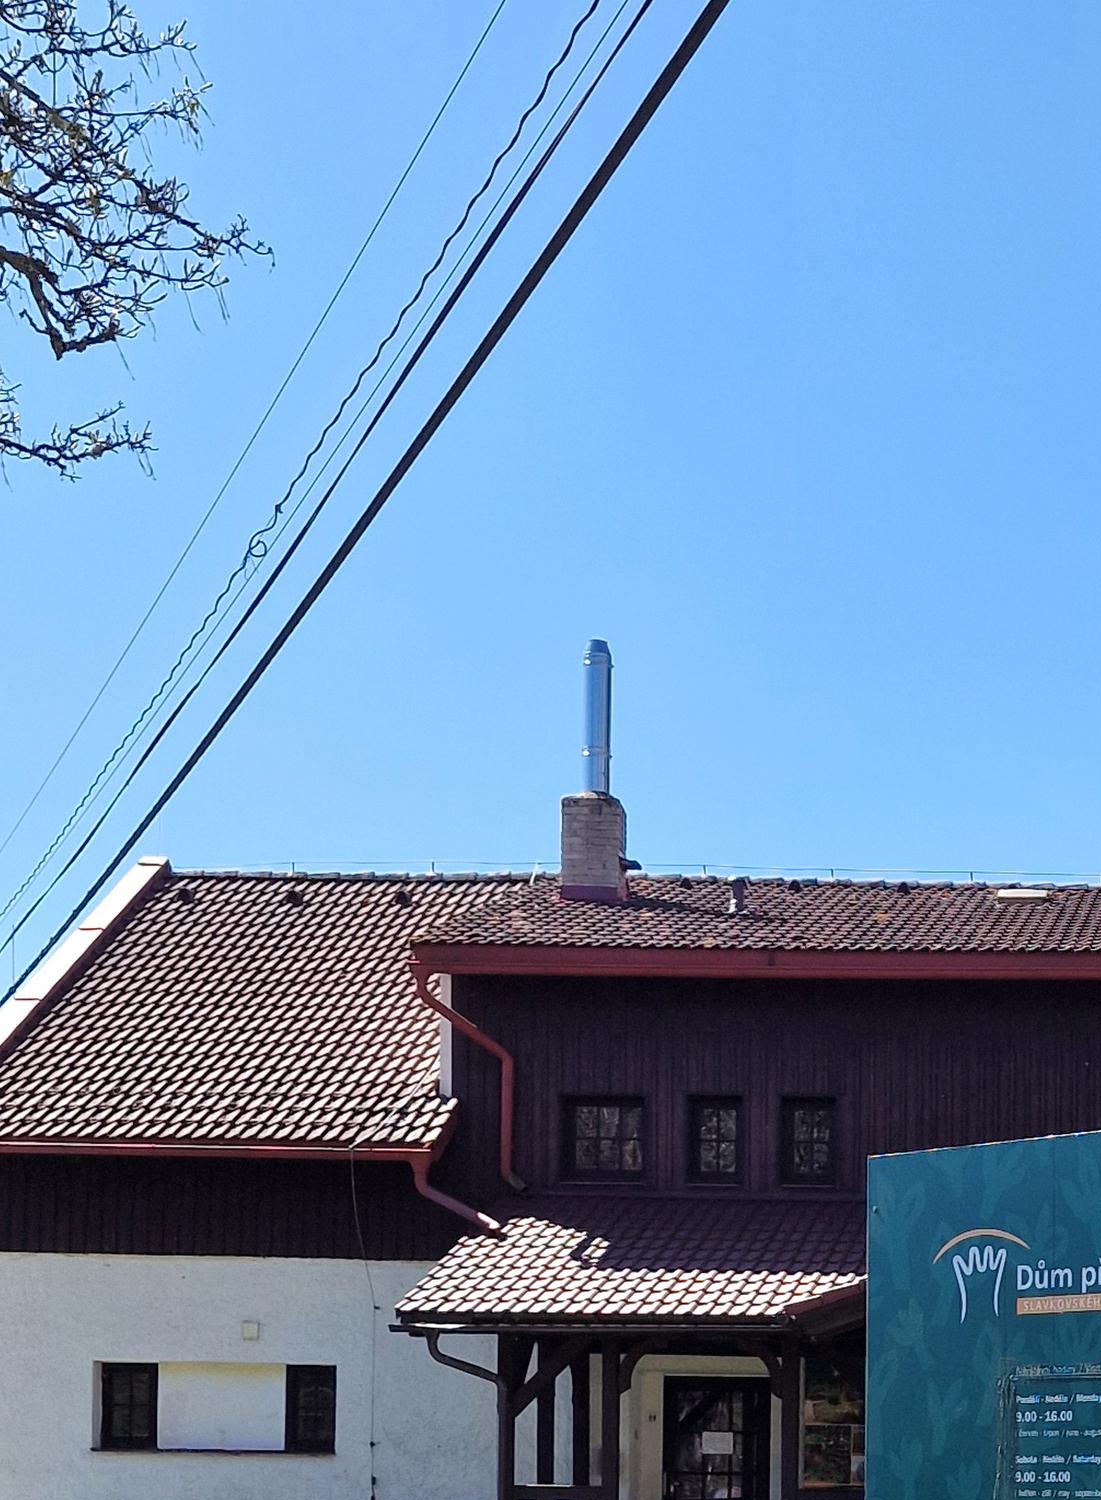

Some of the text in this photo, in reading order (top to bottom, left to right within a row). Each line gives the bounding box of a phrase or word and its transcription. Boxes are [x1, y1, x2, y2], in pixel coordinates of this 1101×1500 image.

[1016, 1259, 1073, 1291] Dům
[1016, 1410, 1073, 1422] 9.00 16.00
[1015, 1471, 1071, 1483] 9.00 16.00
